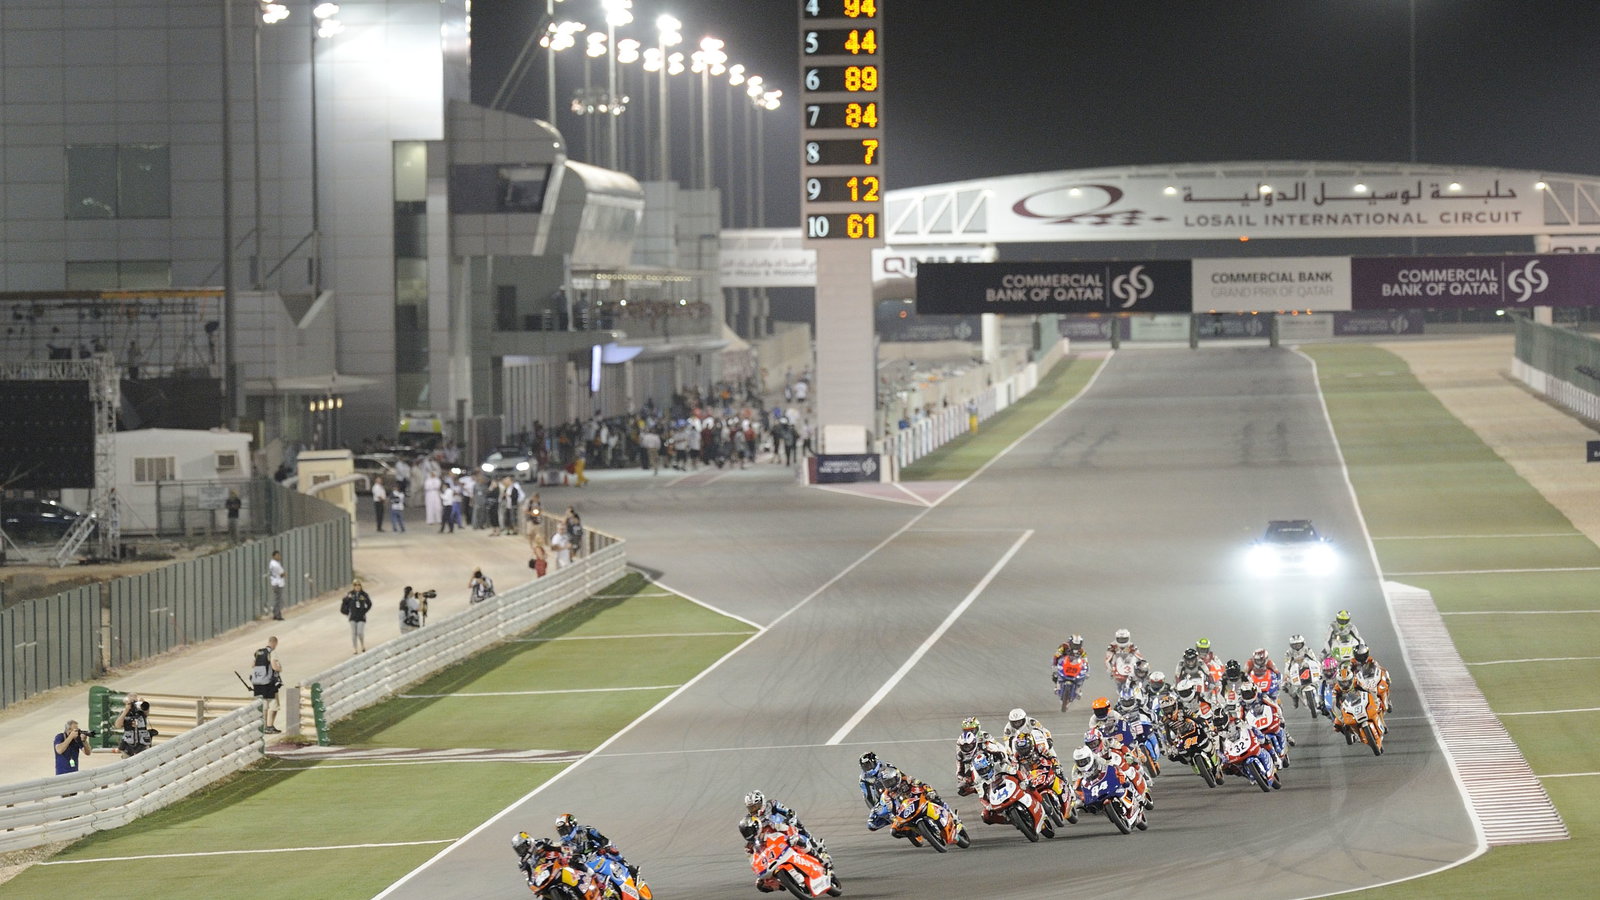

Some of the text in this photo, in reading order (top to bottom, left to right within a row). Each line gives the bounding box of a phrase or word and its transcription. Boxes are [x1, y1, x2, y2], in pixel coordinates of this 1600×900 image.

[805, 0, 876, 18] 4 94
[804, 29, 877, 55] 5 44
[805, 65, 878, 92] 6 89
[807, 103, 878, 128] 7 84
[806, 139, 879, 165] 8 7
[807, 176, 879, 202] 9 12
[807, 213, 876, 239] 10 61
[1184, 210, 1523, 227] LOSAIL INTERNATIONAL CIRCUIT
[1002, 274, 1104, 288] COMMERCIAL
[1211, 270, 1334, 284] COMMERCIAL BANK
[1398, 268, 1499, 283] COMMERCIAL
[985, 286, 1105, 302] BANK OF QATAR
[1211, 285, 1334, 298] GRAND PRIX OF QATAR
[1381, 282, 1499, 297] BANK OF QATAR
[1234, 741, 1247, 754] 32
